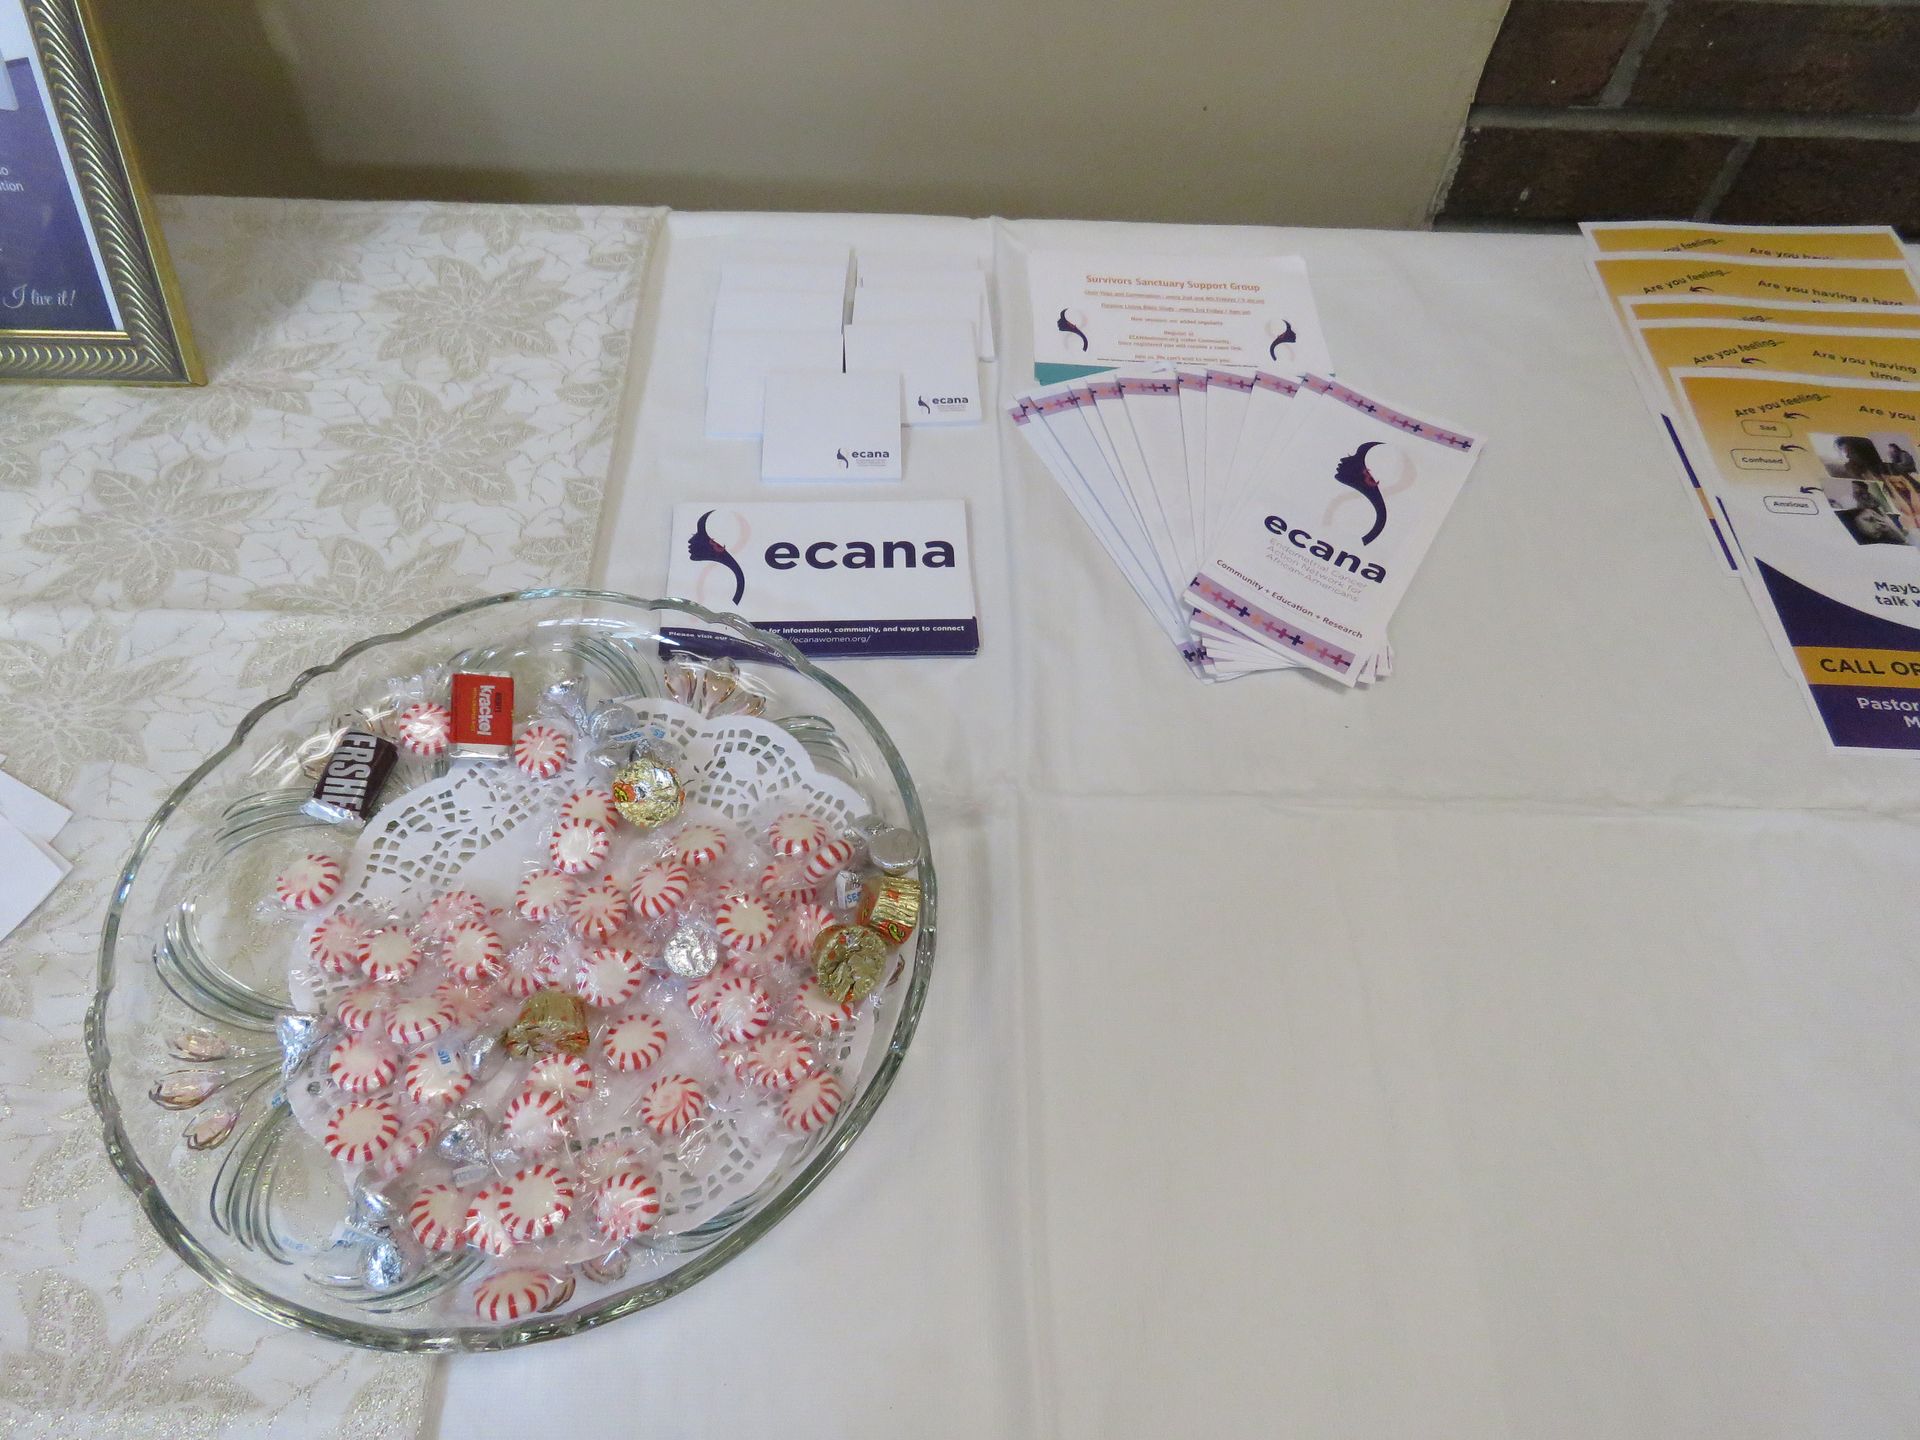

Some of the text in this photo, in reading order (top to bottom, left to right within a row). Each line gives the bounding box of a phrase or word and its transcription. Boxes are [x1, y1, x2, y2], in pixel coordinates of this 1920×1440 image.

[1086, 275, 1261, 292] Survivors Sanctuary Support Group
[1643, 285, 1664, 295] Are
[1668, 277, 1687, 289] you
[1758, 280, 1781, 289] Are
[1784, 285, 1809, 294] you
[1812, 289, 1858, 303] having
[1694, 354, 1715, 365] Are
[1716, 348, 1738, 360] you
[1812, 350, 1917, 374] Are you having
[932, 396, 969, 404] ecana
[1734, 408, 1756, 417] Are
[1759, 403, 1781, 414] you
[1859, 405, 1916, 422] Are you
[851, 450, 890, 458] ecana
[764, 540, 956, 571] ecana
[1264, 514, 1388, 584] ecana
[1216, 559, 1264, 592] Community
[1271, 591, 1313, 617] Education
[1322, 617, 1363, 638] Research
[1875, 594, 1908, 607] talk
[1820, 658, 1885, 675] CALL
[1857, 696, 1919, 712] Pastor
